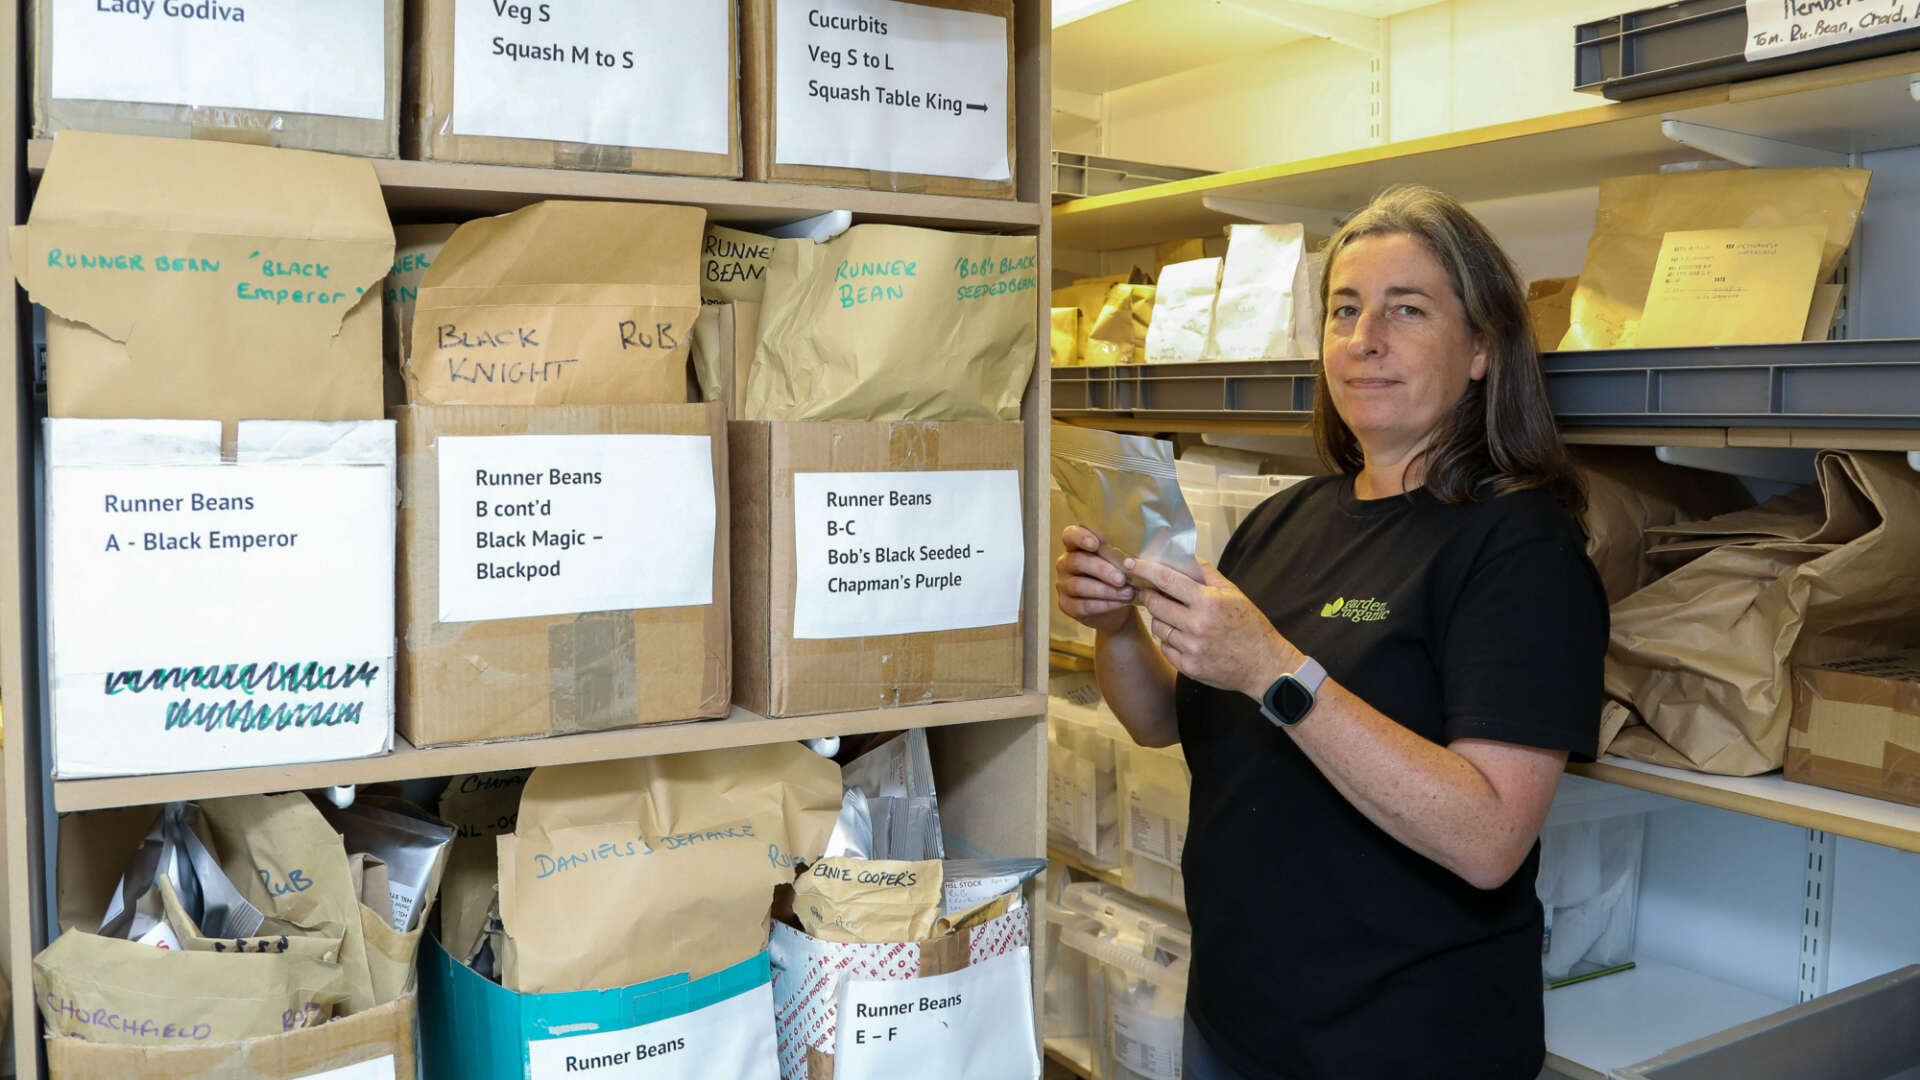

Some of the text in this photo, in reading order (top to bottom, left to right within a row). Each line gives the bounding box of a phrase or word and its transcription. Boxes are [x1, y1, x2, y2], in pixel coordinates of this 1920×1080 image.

[96, 0, 245, 23] Lady Godiva
[492, 0, 551, 25] Veg S
[808, 9, 888, 36] Cucurbits
[1754, 31, 1784, 46] Tom.
[492, 36, 634, 69] Squash M to S
[807, 44, 895, 71] Veg S to L
[808, 79, 963, 117] Squash Table King
[704, 234, 775, 260] RUNNE
[48, 248, 144, 270] RUNNER
[156, 254, 220, 272] BEAN
[706, 260, 765, 282] BEAN
[835, 259, 917, 282] RUNNER
[838, 283, 904, 309] BEAN
[438, 323, 540, 351] BLACK
[448, 355, 580, 386] KNIGHT
[476, 468, 602, 487] Runner Beans
[104, 492, 255, 513] Runner Beans
[476, 499, 551, 518] B cont'd
[826, 490, 932, 508] Runner Beans
[476, 530, 526, 549] Black
[532, 528, 586, 551] Magic
[827, 519, 856, 537] B-C
[104, 533, 121, 552] A
[143, 531, 202, 551] Black
[209, 530, 299, 553] Emperor
[828, 548, 871, 565] Bob's
[875, 546, 916, 564] Black
[919, 543, 971, 561] Seeded
[476, 559, 561, 582] Blackpod
[827, 571, 962, 596] Chapman's Purple
[660, 825, 756, 850] DEFIANCE
[813, 863, 917, 888] ERNIE COOPER'S
[959, 880, 982, 889] STOCK
[857, 993, 962, 1018] Runner Beans
[856, 1029, 866, 1045] E
[888, 1026, 898, 1042] F
[565, 1037, 685, 1073] Runner Beans
